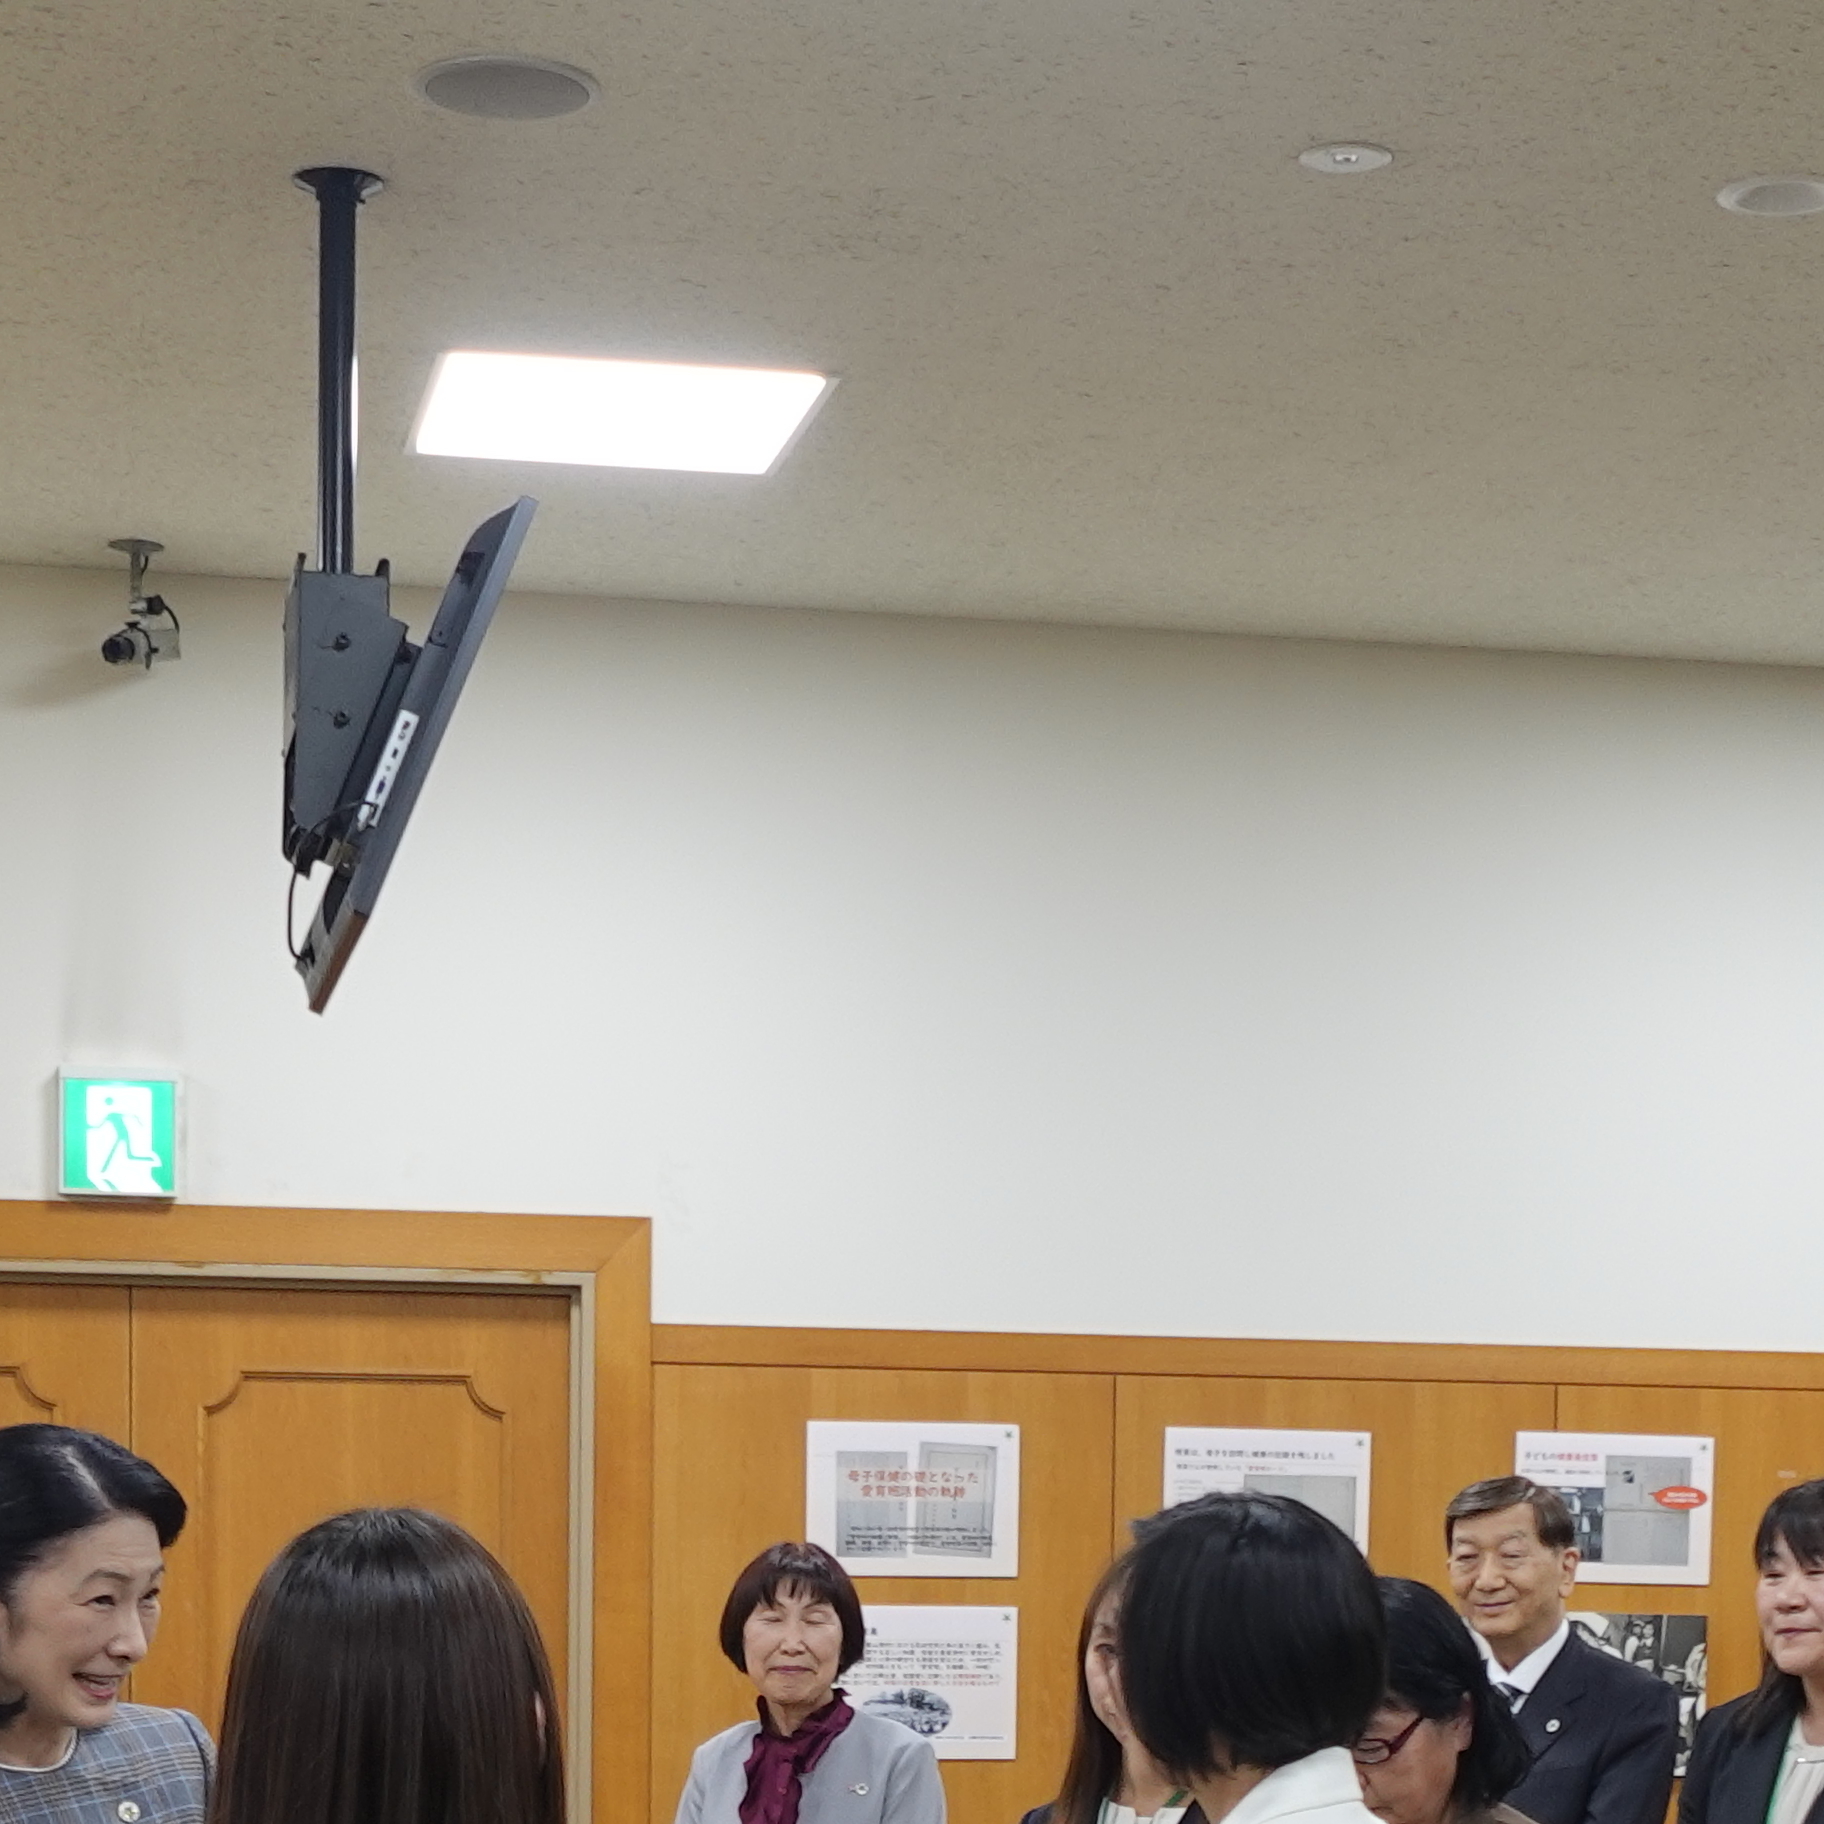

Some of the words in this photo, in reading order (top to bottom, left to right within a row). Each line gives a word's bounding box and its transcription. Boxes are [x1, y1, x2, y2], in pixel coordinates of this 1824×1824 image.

[846, 1470, 979, 1484] 母子保健の礎となった
